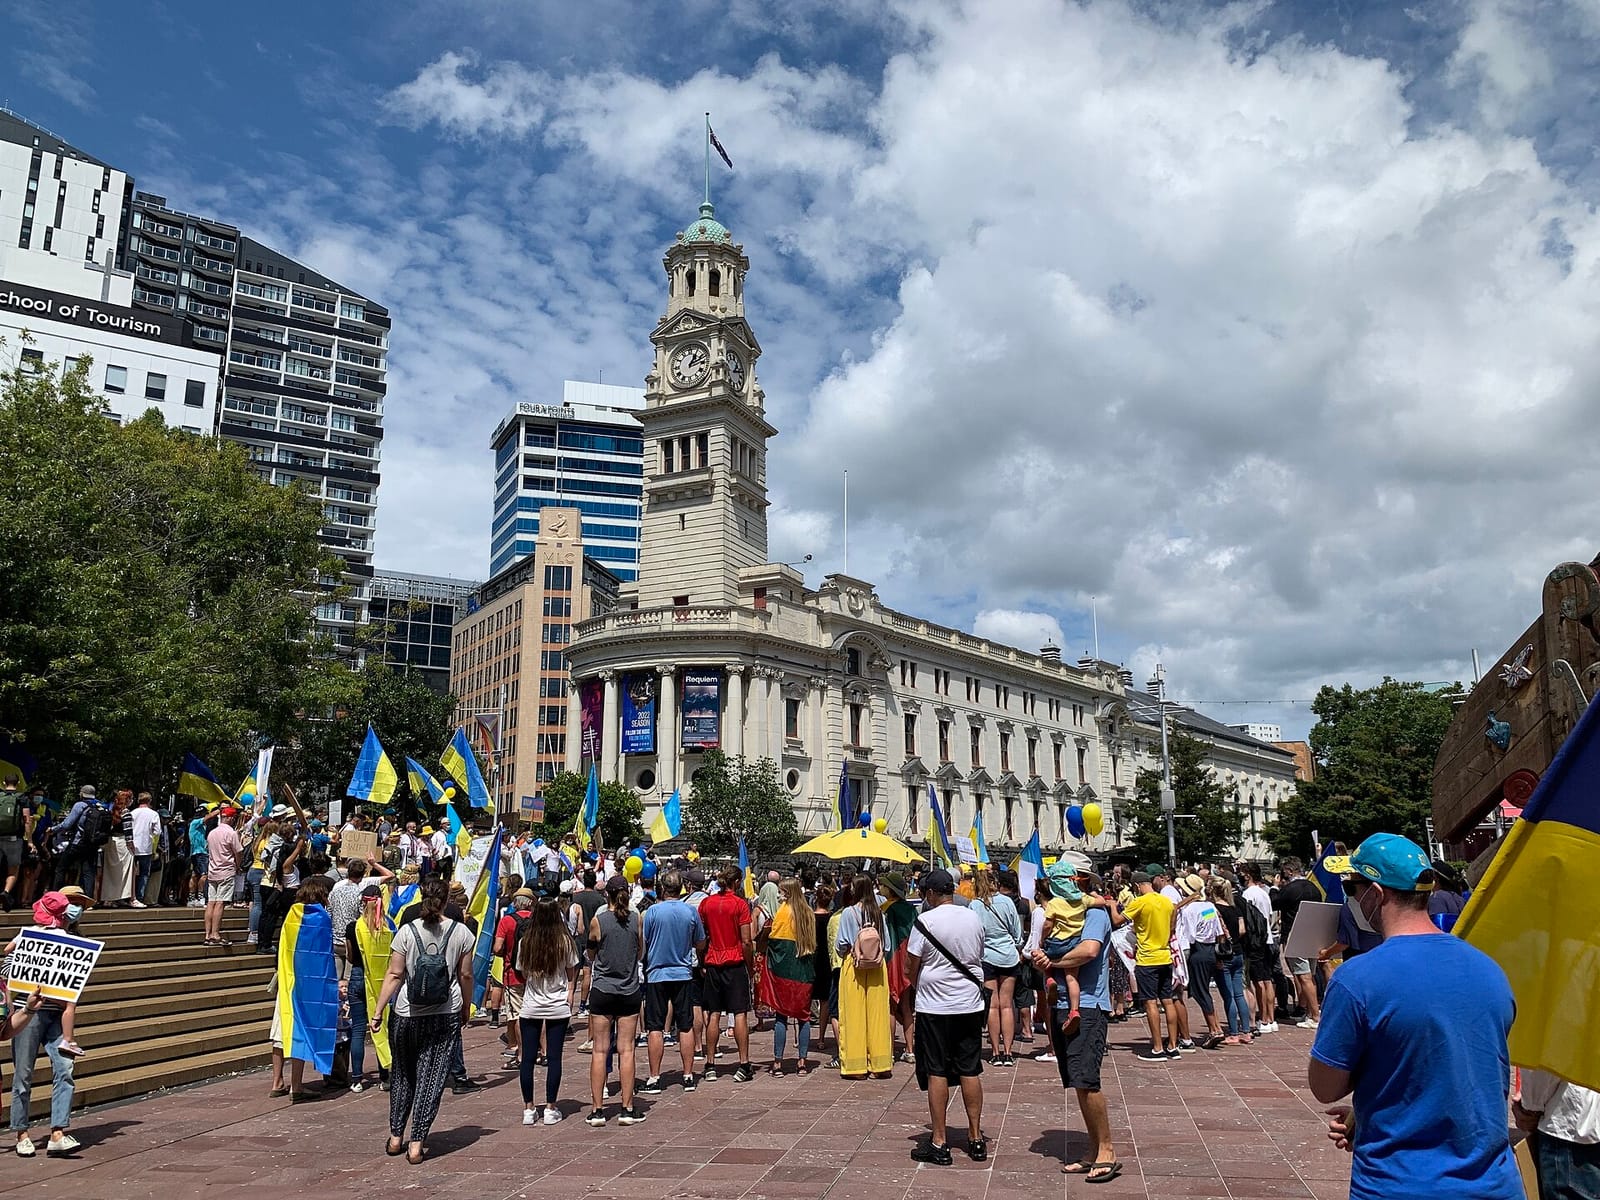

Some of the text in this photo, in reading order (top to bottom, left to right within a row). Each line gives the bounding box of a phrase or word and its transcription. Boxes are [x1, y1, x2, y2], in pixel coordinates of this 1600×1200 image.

[0, 291, 161, 336] chool of Tourism
[685, 675, 718, 684] Requiem
[631, 719, 651, 728] SEASON
[637, 711, 650, 720] 2022
[345, 831, 371, 842] CUT
[17, 939, 94, 963] AOTEAROA
[14, 952, 90, 975] STANDS WITH
[11, 965, 84, 990] UKRAINE
